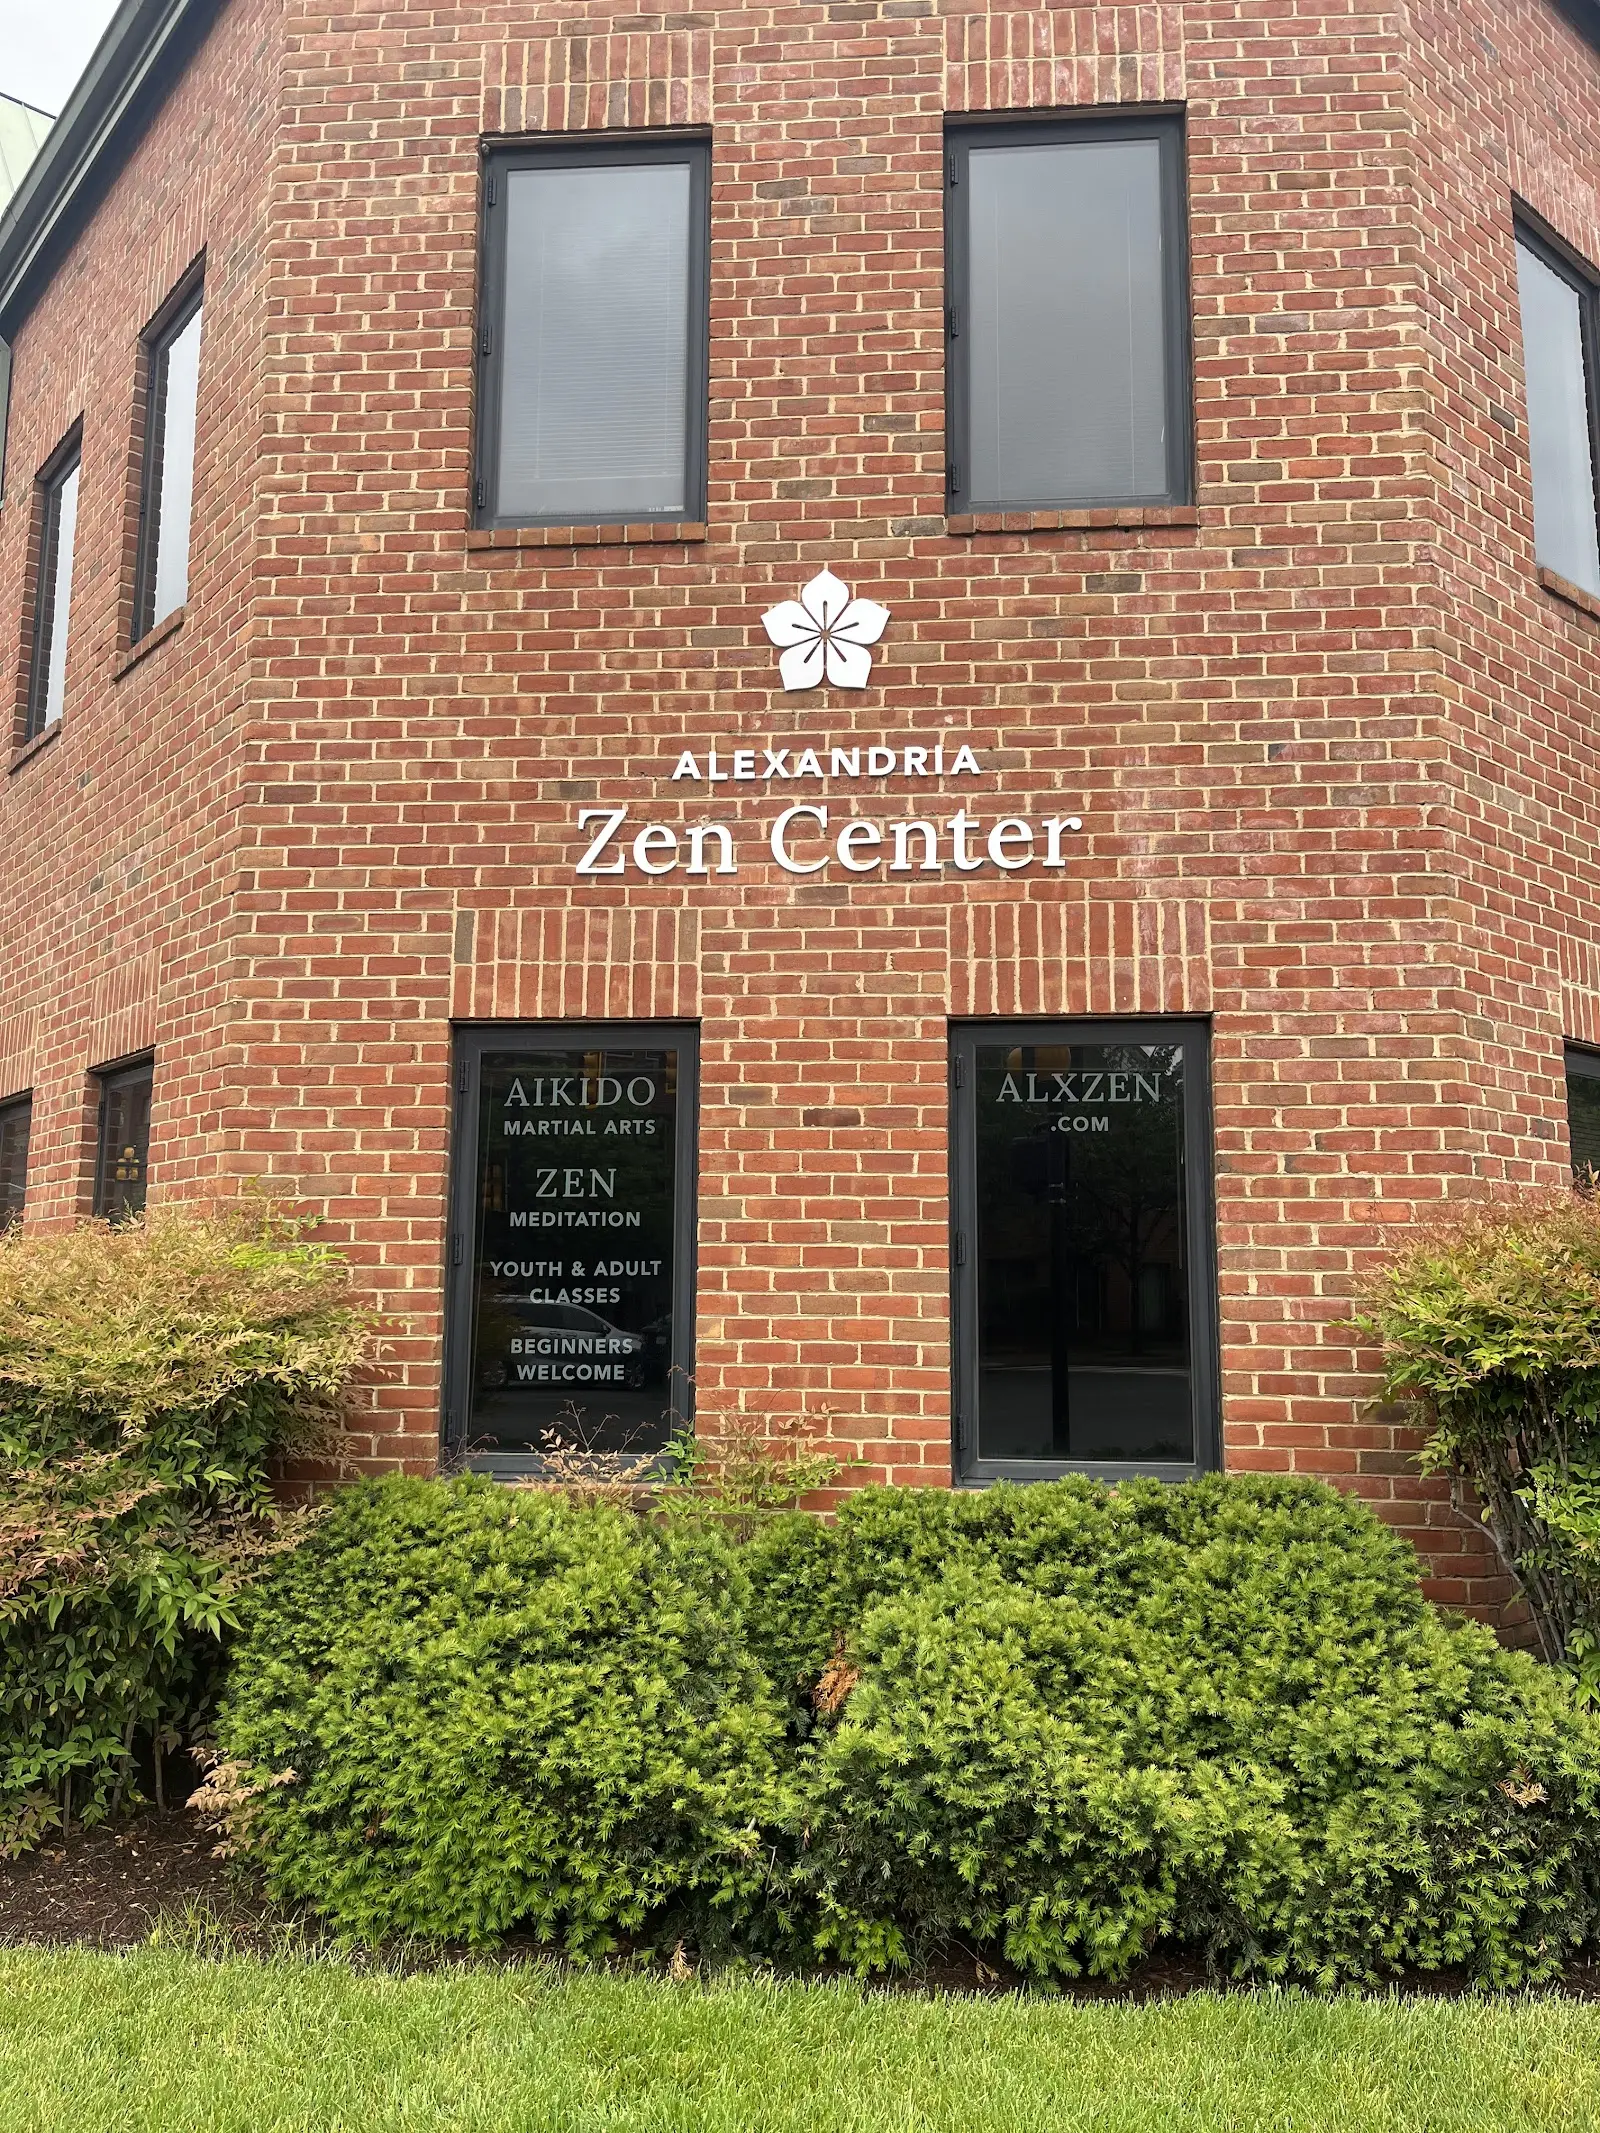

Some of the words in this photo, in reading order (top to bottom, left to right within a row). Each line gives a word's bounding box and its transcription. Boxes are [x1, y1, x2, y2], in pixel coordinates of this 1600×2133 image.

[672, 745, 981, 781] ALEXANDRIA
[575, 808, 738, 875] Zen
[771, 805, 1082, 873] Center
[504, 1076, 656, 1107] AIKIDO
[996, 1072, 1161, 1103] ALXZEN
[503, 1120, 597, 1136] MARTIAL
[604, 1119, 656, 1135] ARTS
[1051, 1116, 1110, 1133] .COM
[535, 1168, 617, 1198] ZEN
[509, 1211, 641, 1227] MEDITATION
[490, 1261, 563, 1277] YOUTH
[571, 1261, 586, 1277] &
[594, 1260, 661, 1276] ADULT
[530, 1288, 620, 1304] CLASSES
[510, 1338, 633, 1355] BEGINNERS
[517, 1364, 625, 1381] WELCOME
